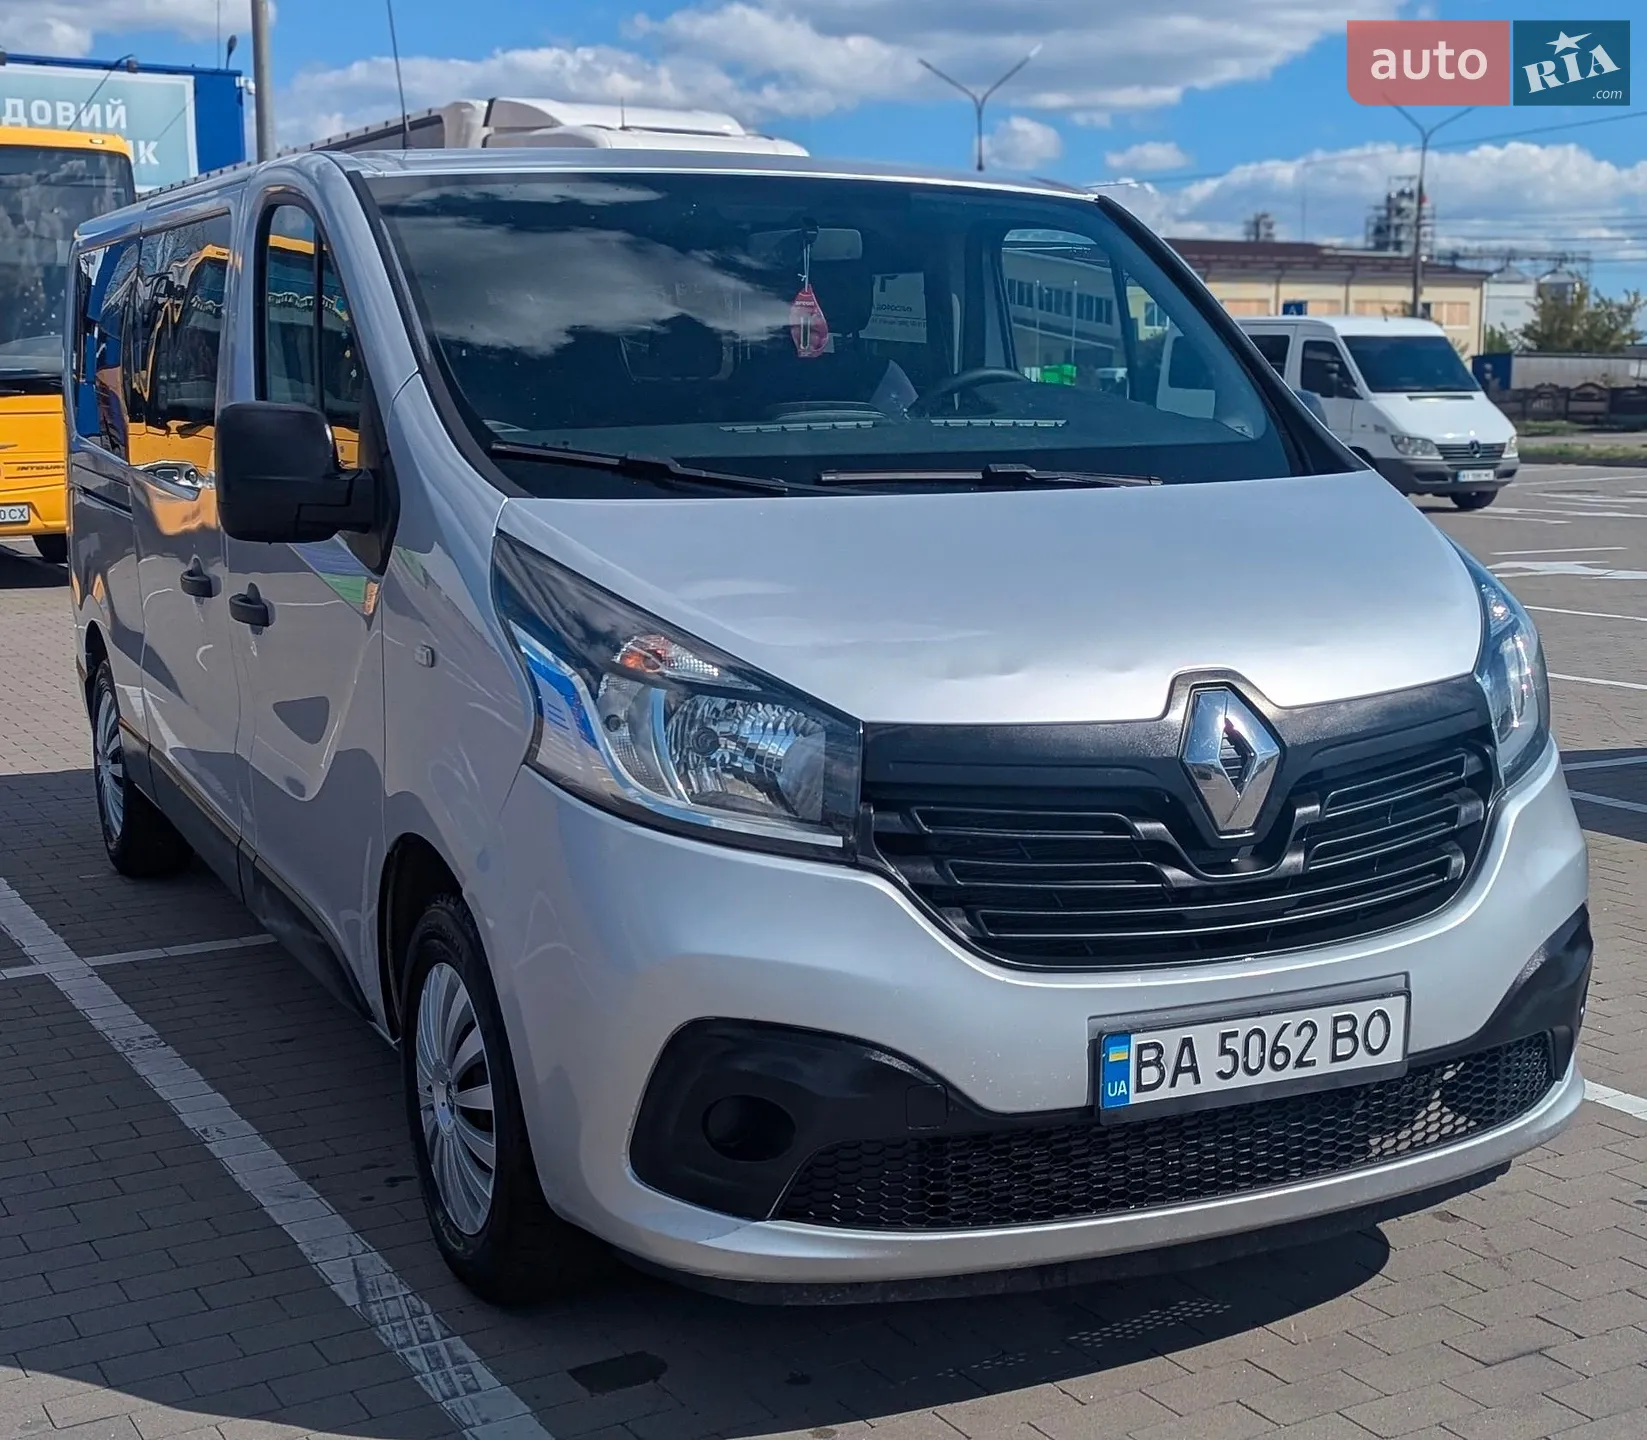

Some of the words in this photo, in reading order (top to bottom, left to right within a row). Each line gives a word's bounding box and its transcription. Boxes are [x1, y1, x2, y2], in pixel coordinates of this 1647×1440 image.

[1135, 1034, 1202, 1094] BA
[1216, 1019, 1319, 1081] 5062
[1330, 1007, 1392, 1064] BO
[1107, 1079, 1128, 1097] UA
